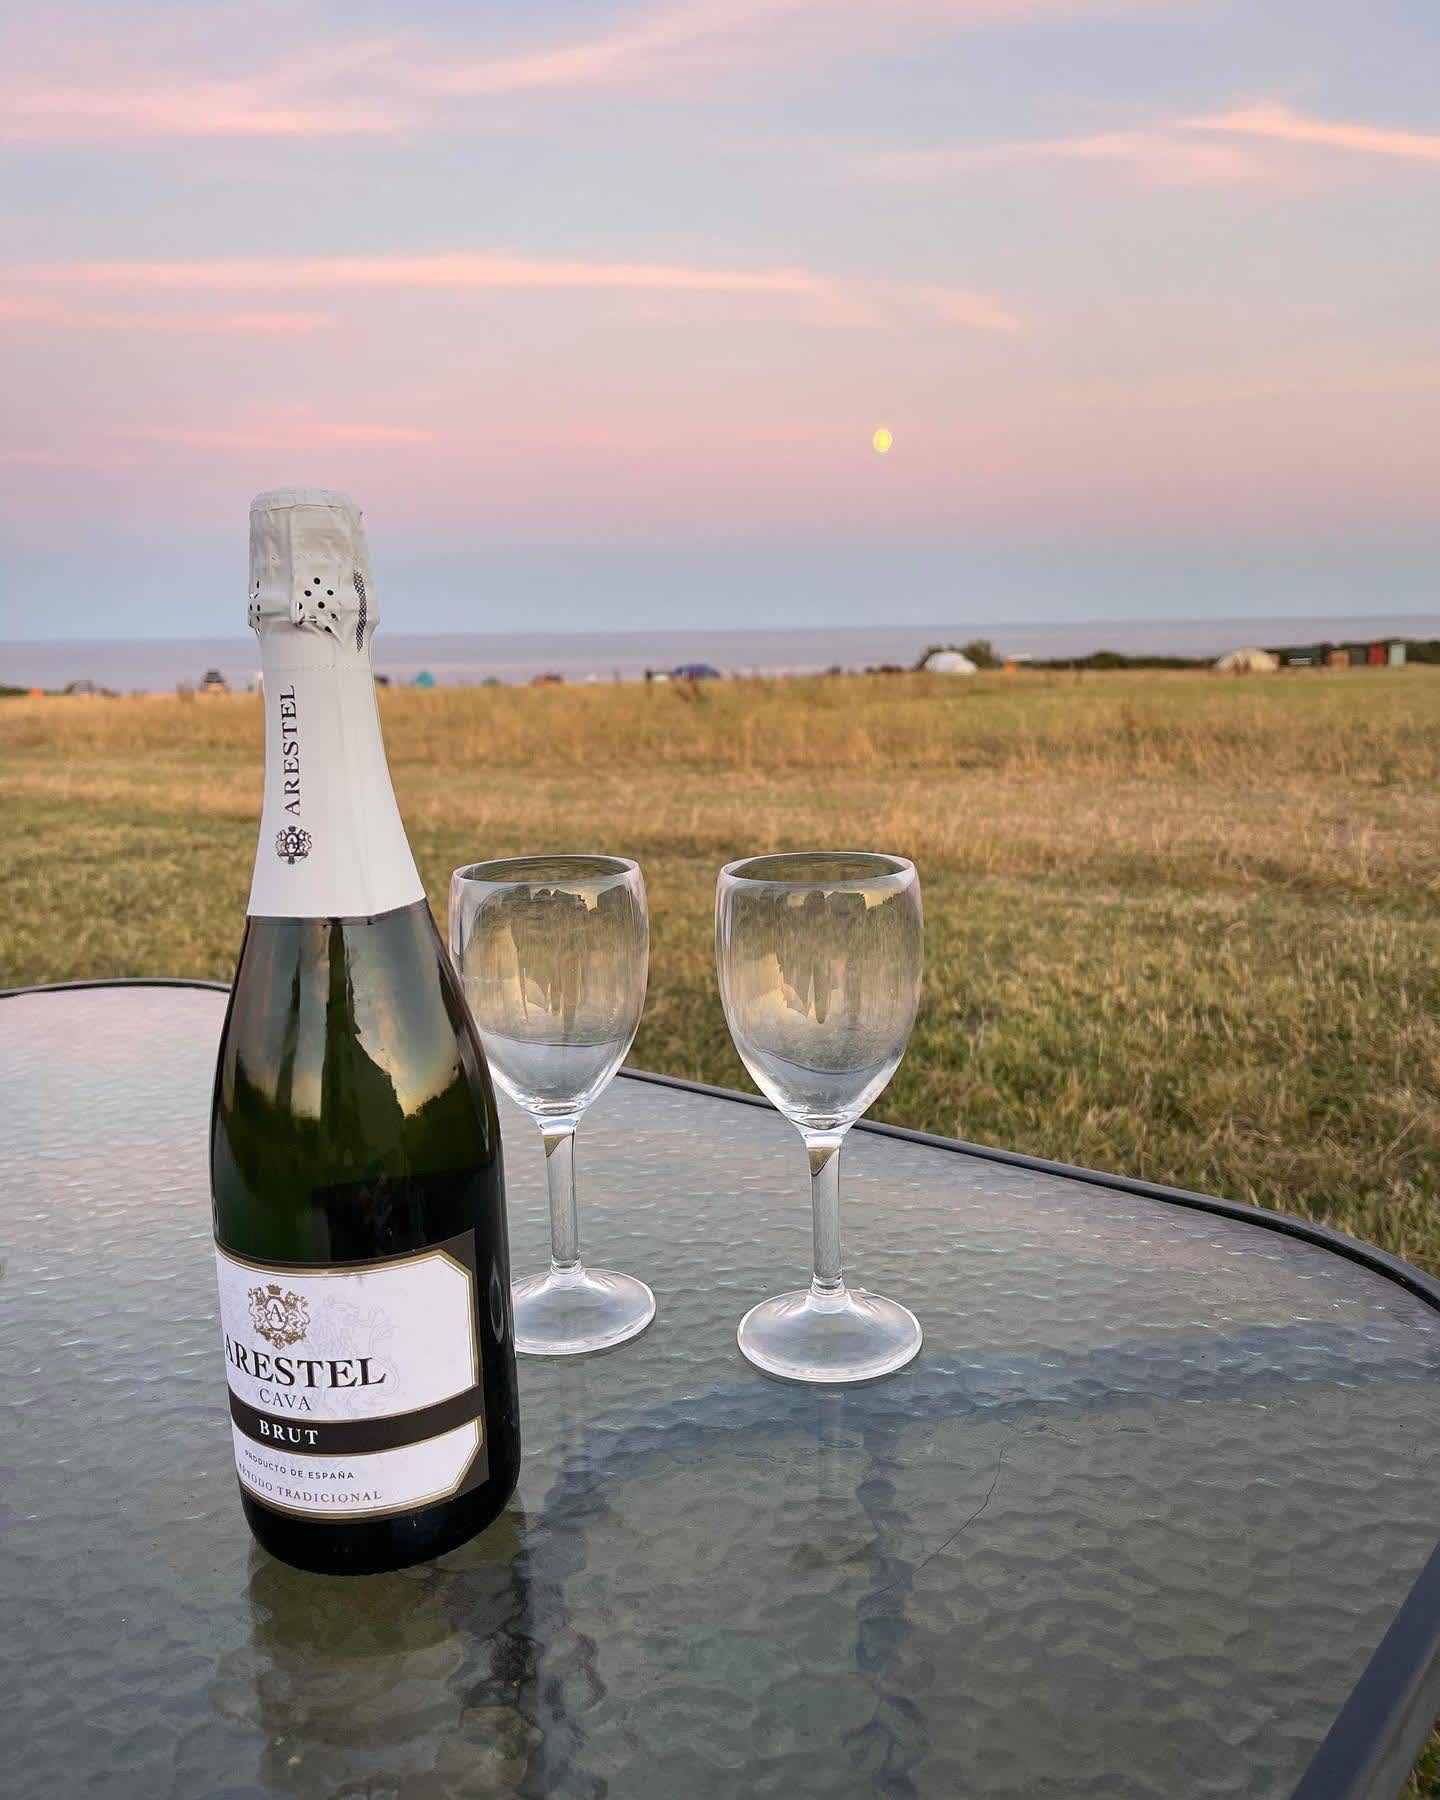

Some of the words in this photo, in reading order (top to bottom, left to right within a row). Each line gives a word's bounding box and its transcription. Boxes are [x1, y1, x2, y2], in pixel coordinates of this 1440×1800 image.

[280, 685, 301, 816] ARESTEL
[269, 1304, 283, 1322] A
[225, 1333, 387, 1388] ARESTEL
[259, 1388, 312, 1411] CAVA
[259, 1419, 318, 1445] BRUT
[245, 1450, 287, 1474] PRODUCTO
[290, 1468, 303, 1478] DE
[308, 1470, 354, 1480] ESPAÑA
[277, 1486, 382, 1503] TRADICIONAL
